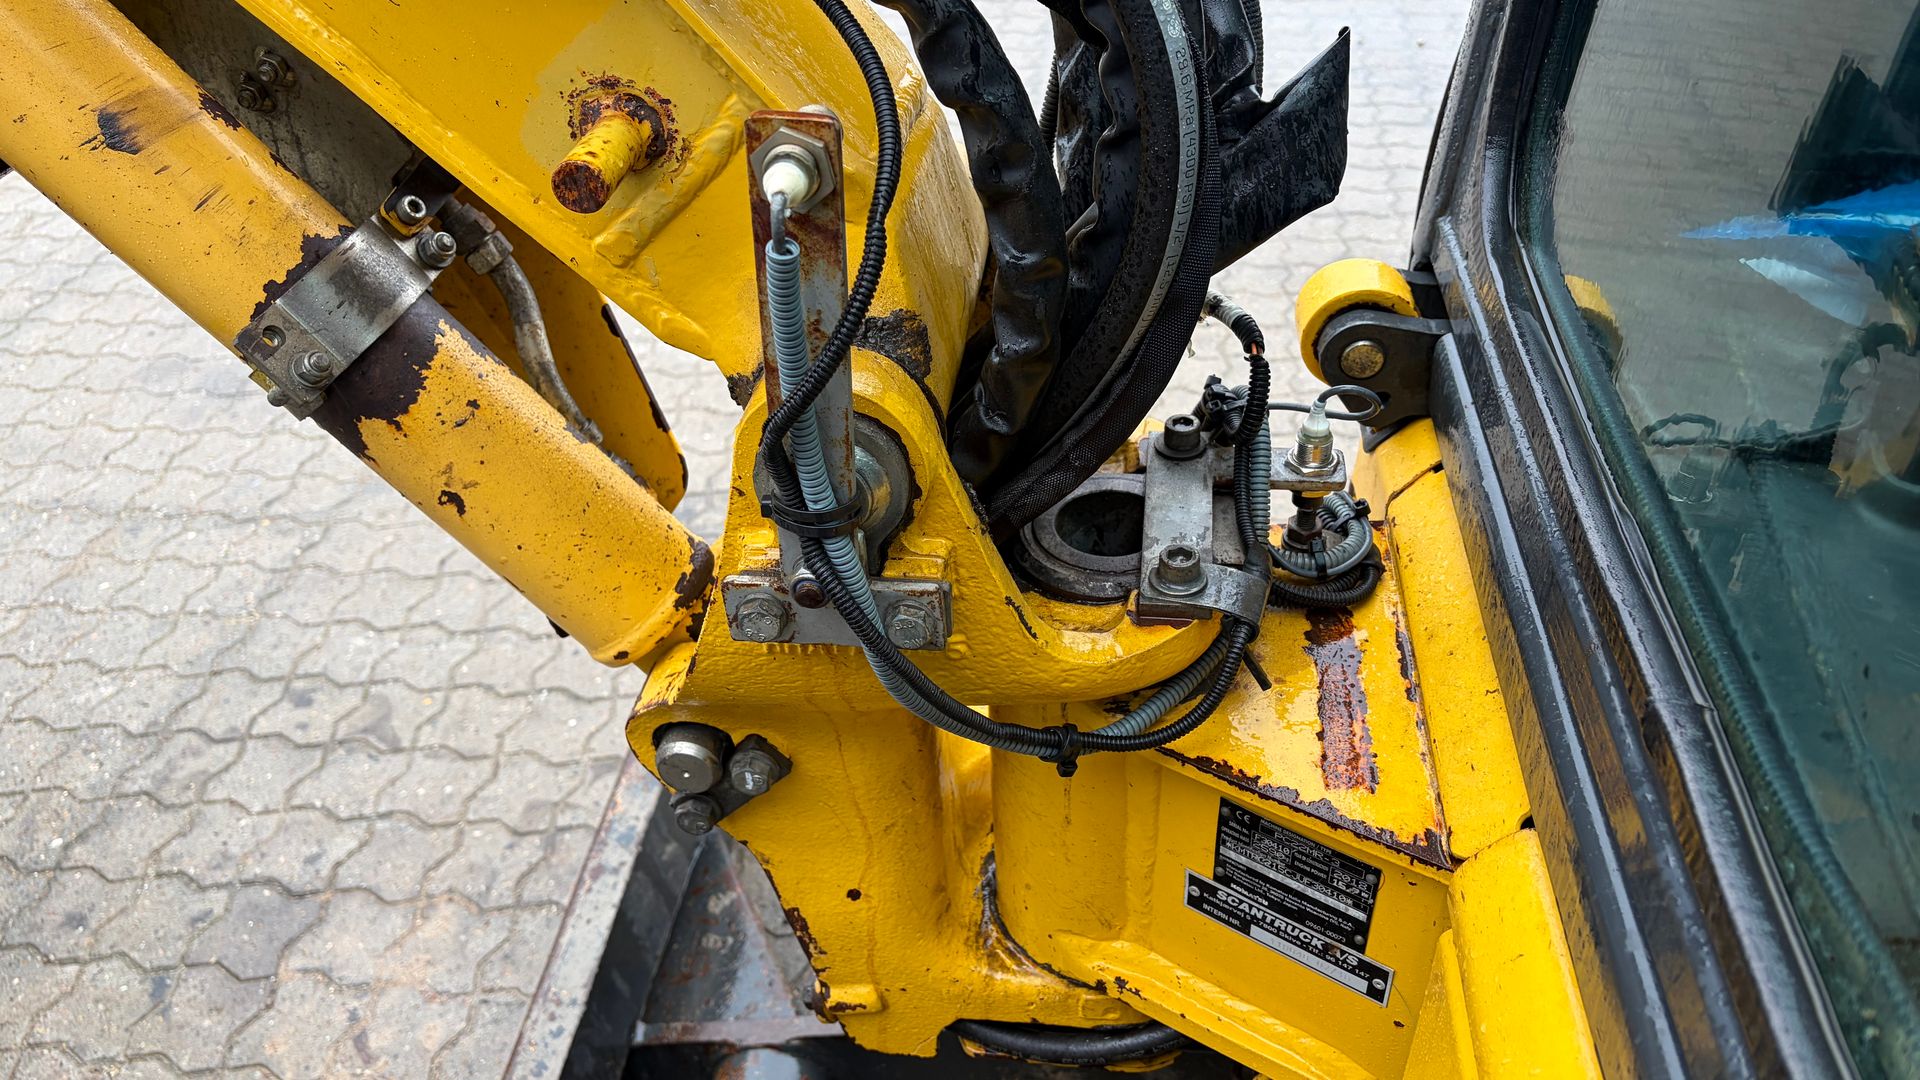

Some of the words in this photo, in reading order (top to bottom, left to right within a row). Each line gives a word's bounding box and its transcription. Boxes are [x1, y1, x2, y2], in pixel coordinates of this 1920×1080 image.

[1182, 89, 1195, 125] MPa
[1202, 902, 1228, 920] INTERN
[1216, 889, 1325, 950] SCANTRUCK
